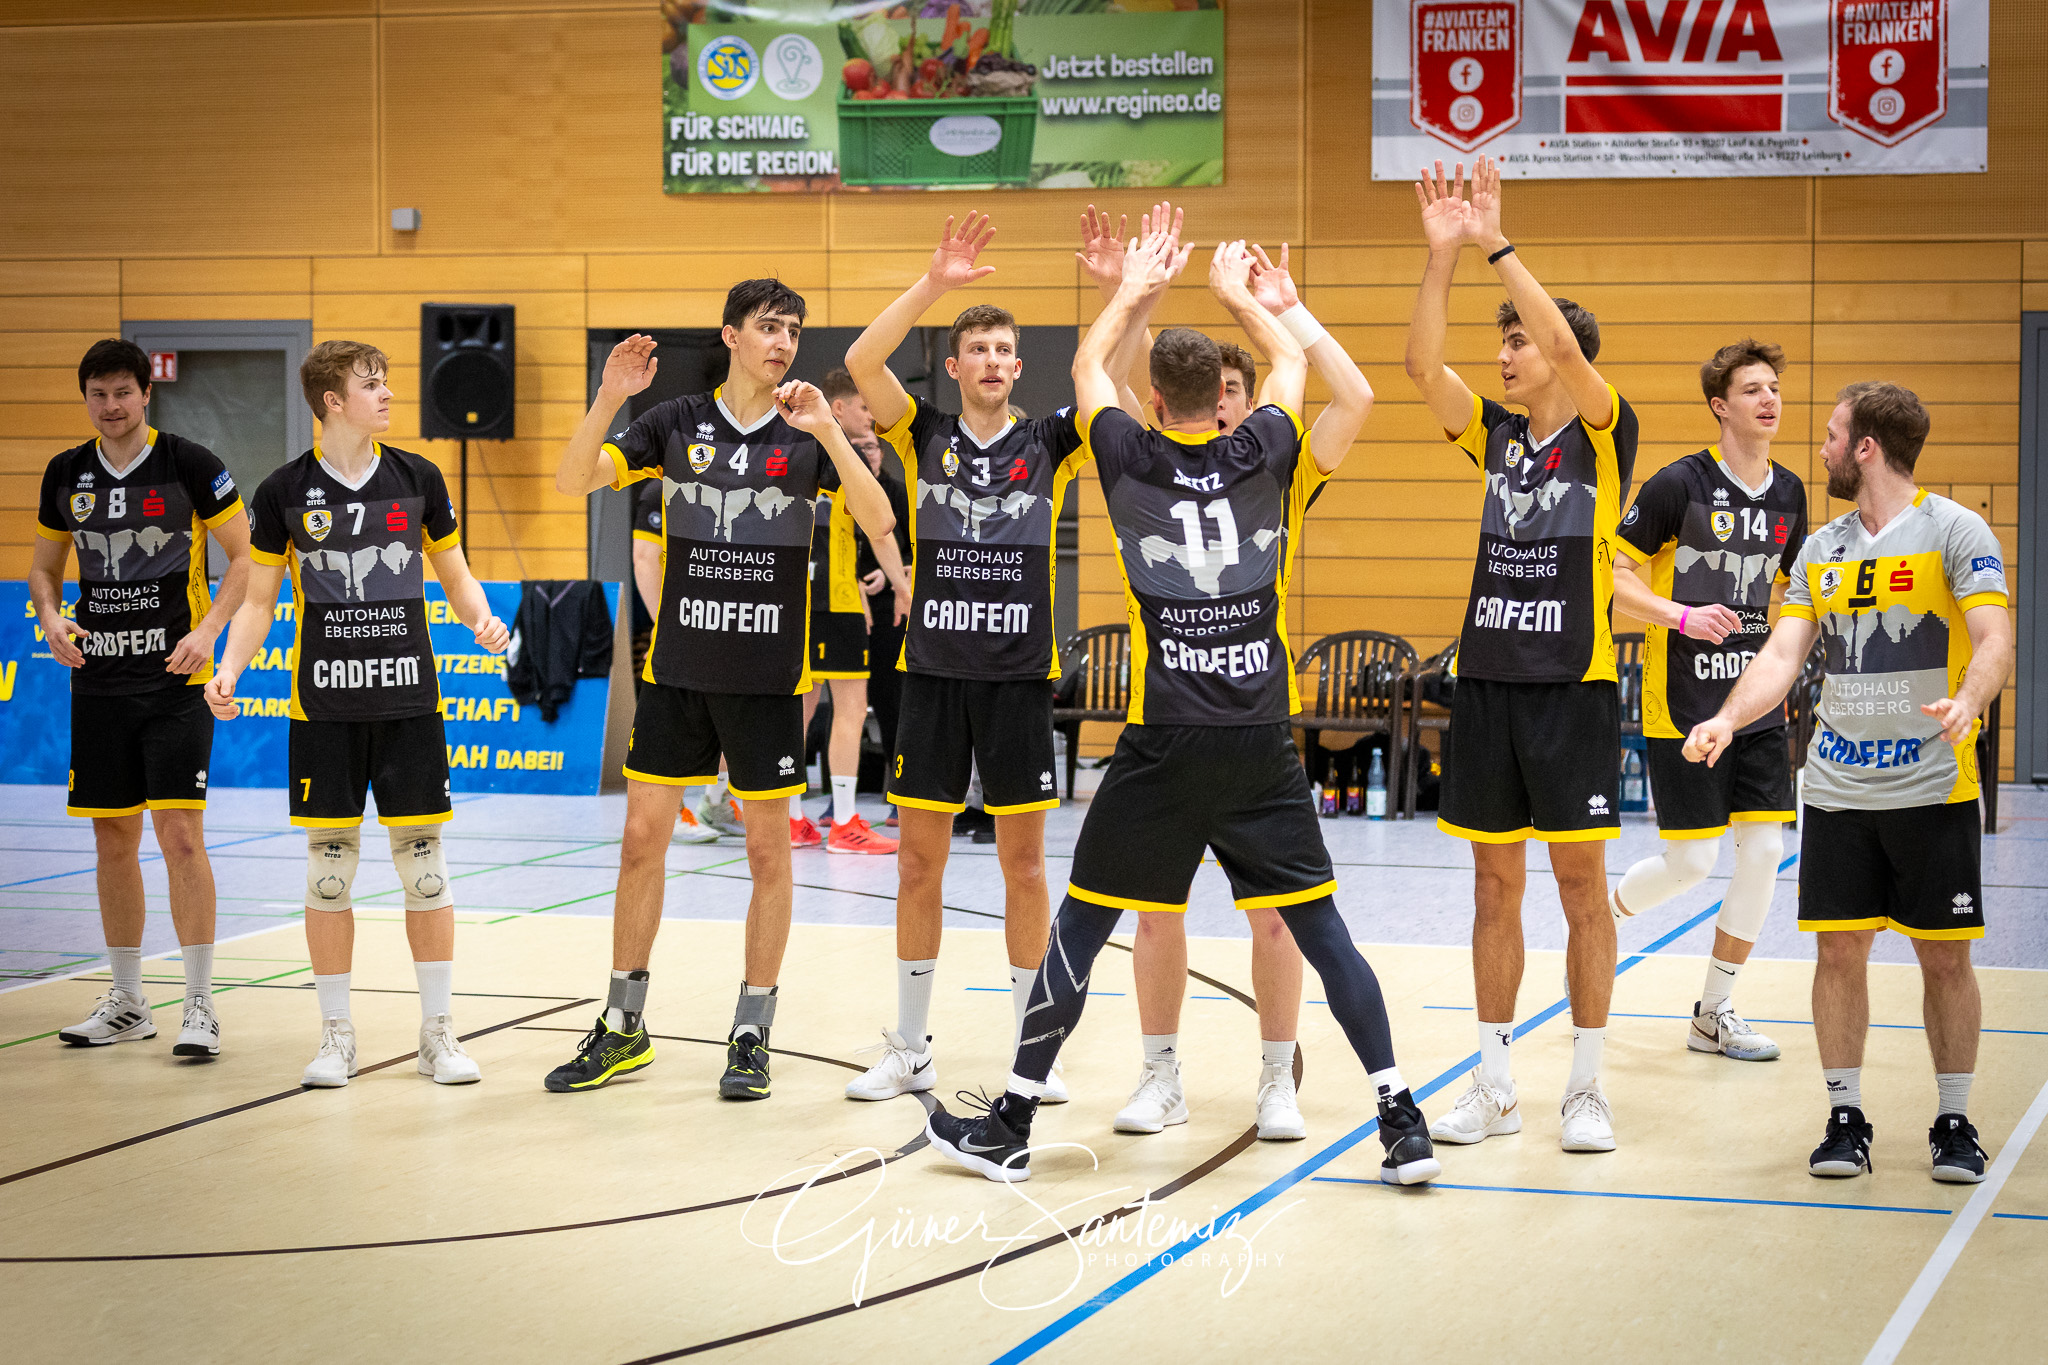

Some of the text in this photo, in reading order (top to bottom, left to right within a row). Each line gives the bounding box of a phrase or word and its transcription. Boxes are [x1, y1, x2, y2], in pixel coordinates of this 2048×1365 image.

[1423, 9, 1509, 29] #AVIATEAM
[1567, 0, 1783, 62] AVIA
[1843, 20, 1933, 45] FRANKEN
[1423, 29, 1510, 52] FRANKEN
[1042, 50, 1213, 78] Jetzt bestellen
[1042, 87, 1221, 119] www.regineo.de
[670, 112, 809, 140] FÜR SCHWAIG.
[670, 148, 839, 176] FÜR DIE REGION.
[728, 443, 748, 475] 4
[971, 457, 990, 487] 3
[108, 487, 126, 518] 8
[346, 503, 366, 535] 7
[1169, 497, 1240, 568] 11
[1740, 507, 1768, 542] 14
[689, 547, 775, 565] AUTOHAUS
[936, 548, 1023, 565] AUTOHAUS
[688, 564, 774, 582] EBERSBERG
[936, 565, 1022, 582] EBERSBERG
[1856, 559, 1877, 595] 6
[324, 607, 405, 622] AUTOHAUS
[679, 597, 779, 633] CADFEM
[923, 599, 1029, 634] CADFEM
[1160, 599, 1261, 623] AUTOHAUS
[82, 628, 166, 657] CADFEM
[325, 623, 408, 638] EBERSBERG
[313, 656, 419, 689] CADFEM
[1829, 700, 1911, 716] EBERSBERG
[495, 749, 564, 770] DABEI!
[895, 754, 904, 779] 3
[300, 778, 311, 802] 7
[1952, 906, 1974, 914] errea
